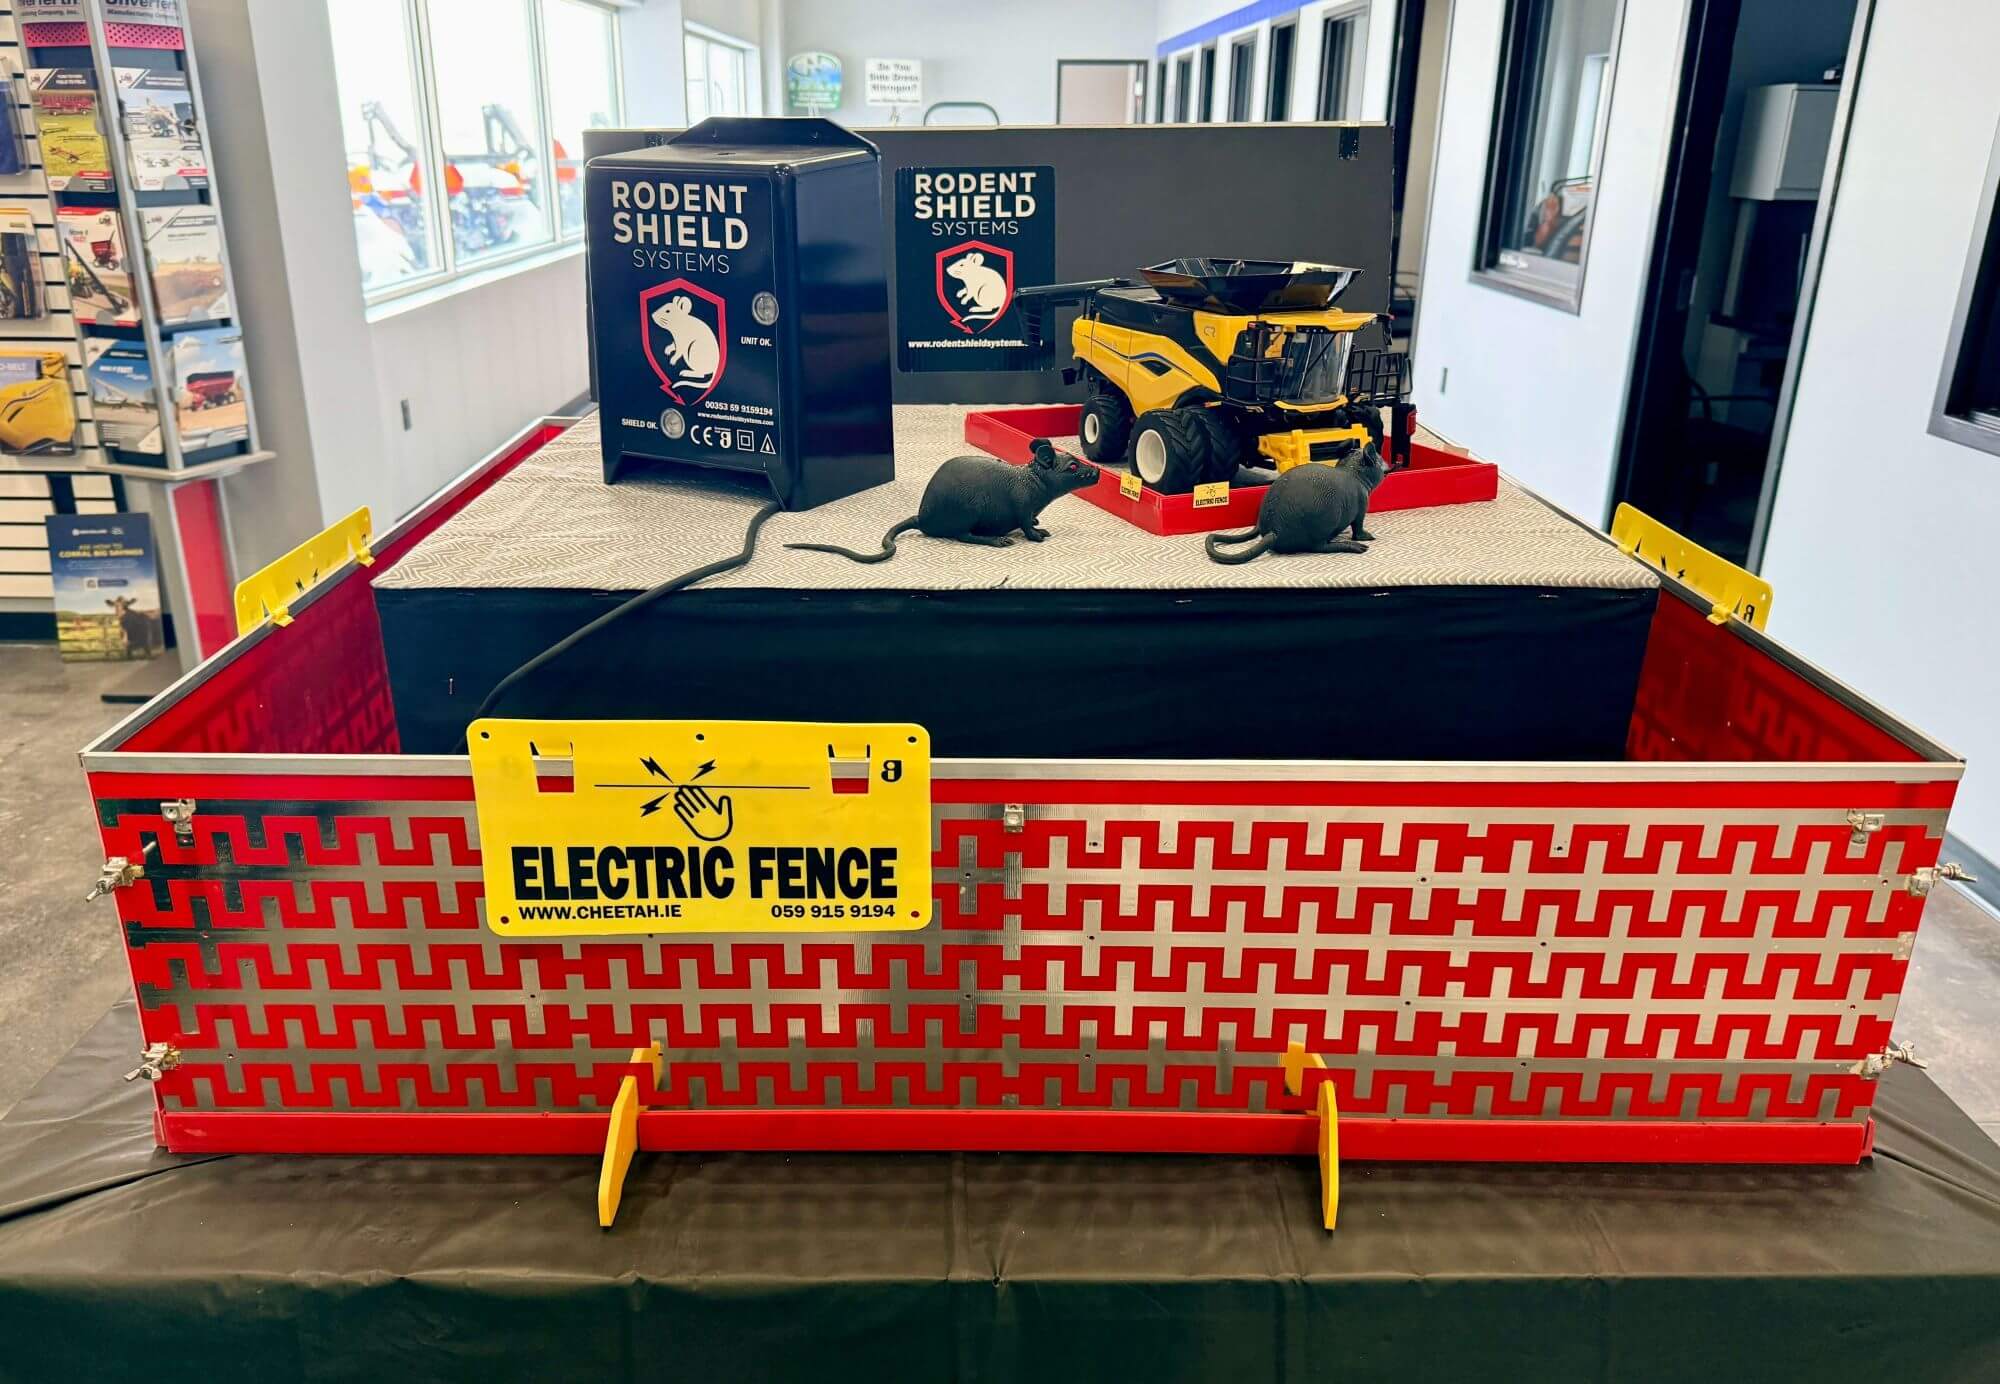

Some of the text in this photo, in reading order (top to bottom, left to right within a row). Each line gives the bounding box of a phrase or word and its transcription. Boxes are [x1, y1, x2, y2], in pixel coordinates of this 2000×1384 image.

[915, 172, 1037, 194] RODENT
[611, 181, 748, 214] RODENT
[914, 195, 1036, 219] SHIELD
[613, 211, 749, 250] SHIELD
[931, 221, 1019, 236] SYSTEMS
[632, 248, 730, 274] SYSTEMS
[740, 336, 773, 347] UNIT OK.
[908, 339, 1043, 349] www.rodentshieldsystems.
[705, 400, 774, 417] 00353 59 9159194
[621, 417, 659, 430] SHIELD OK.
[1195, 496, 1228, 506] ELECTRIC FENCE
[511, 845, 898, 900] ELECTRIC FENCE
[518, 904, 896, 920] WWW.CHEETAH.IE 059 915 9194
